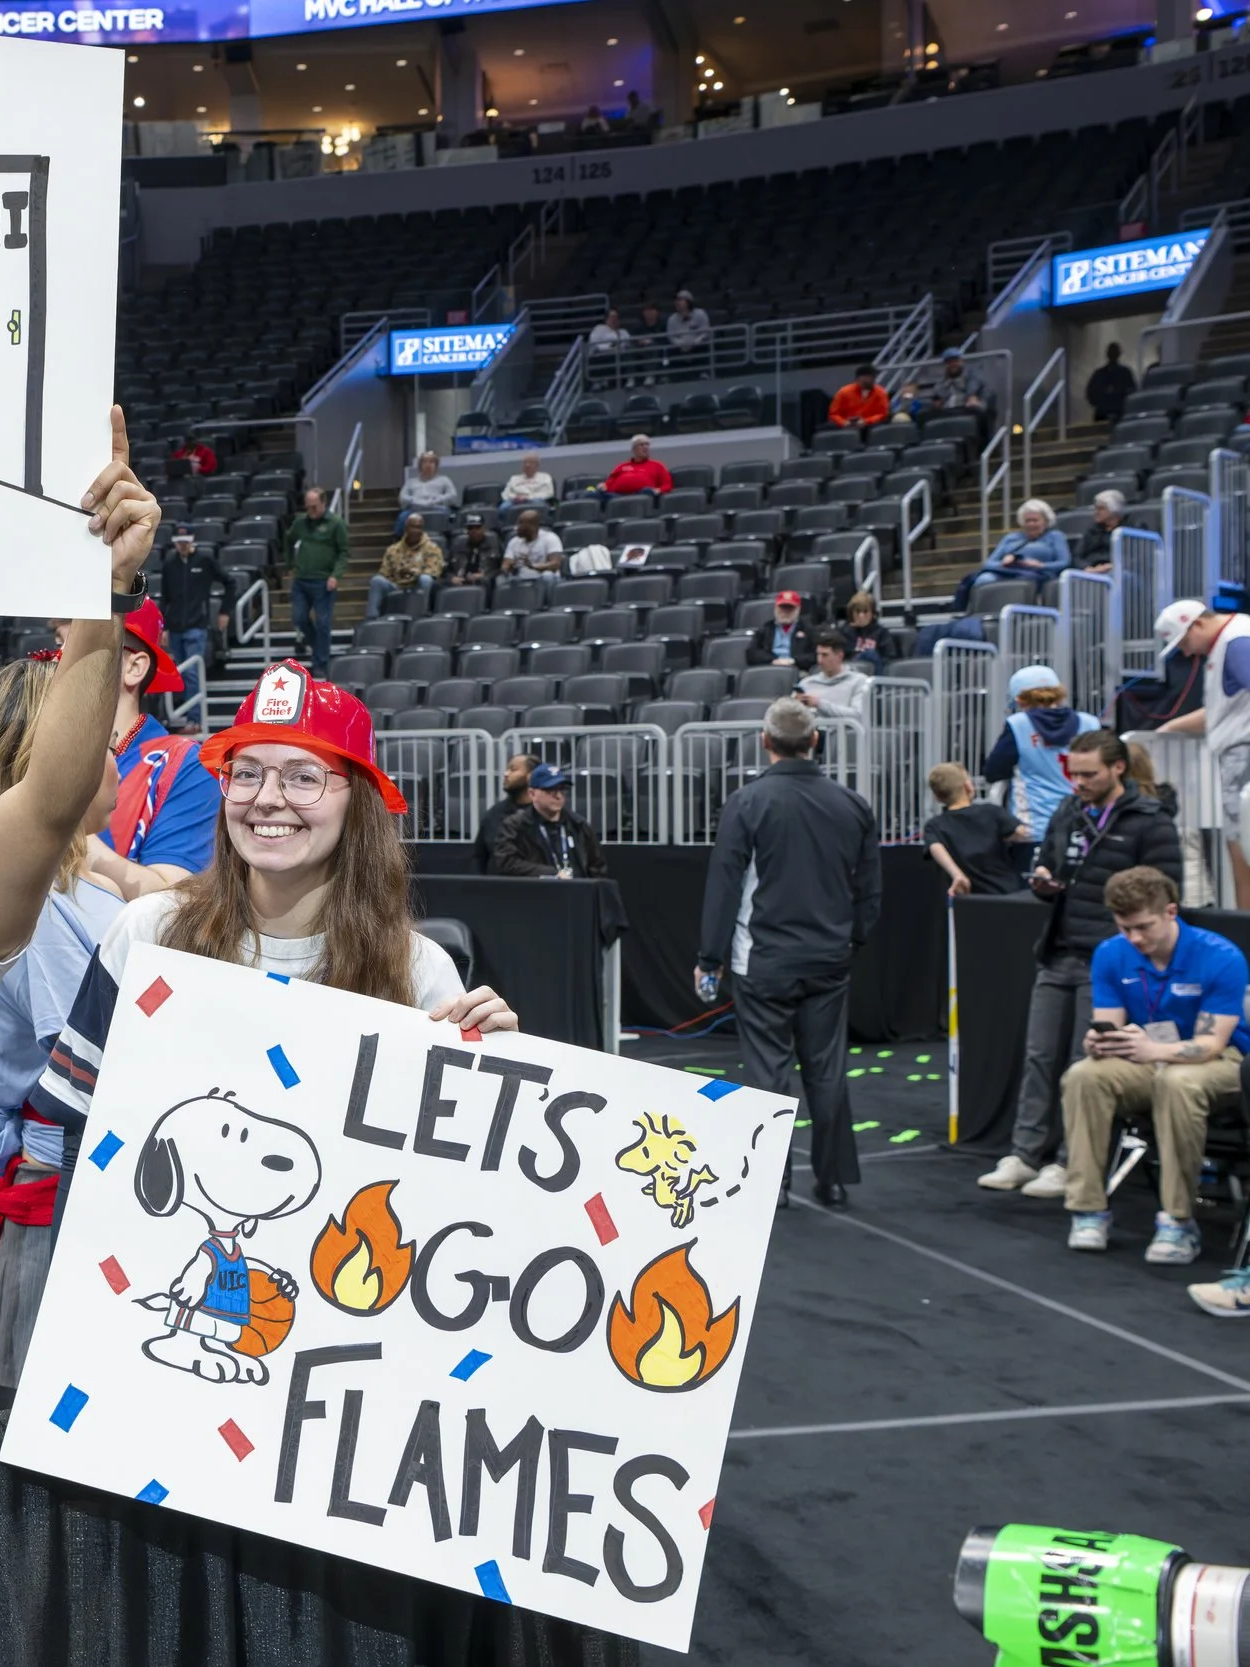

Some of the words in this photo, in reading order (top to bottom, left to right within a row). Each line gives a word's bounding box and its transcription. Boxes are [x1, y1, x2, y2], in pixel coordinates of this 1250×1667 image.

[57, 8, 164, 32] CENTER
[261, 707, 292, 716] Chief
[267, 698, 289, 707] Fire
[343, 1033, 607, 1192] LET'S
[219, 1270, 246, 1291] UIC
[274, 1342, 690, 1603] FLAMES
